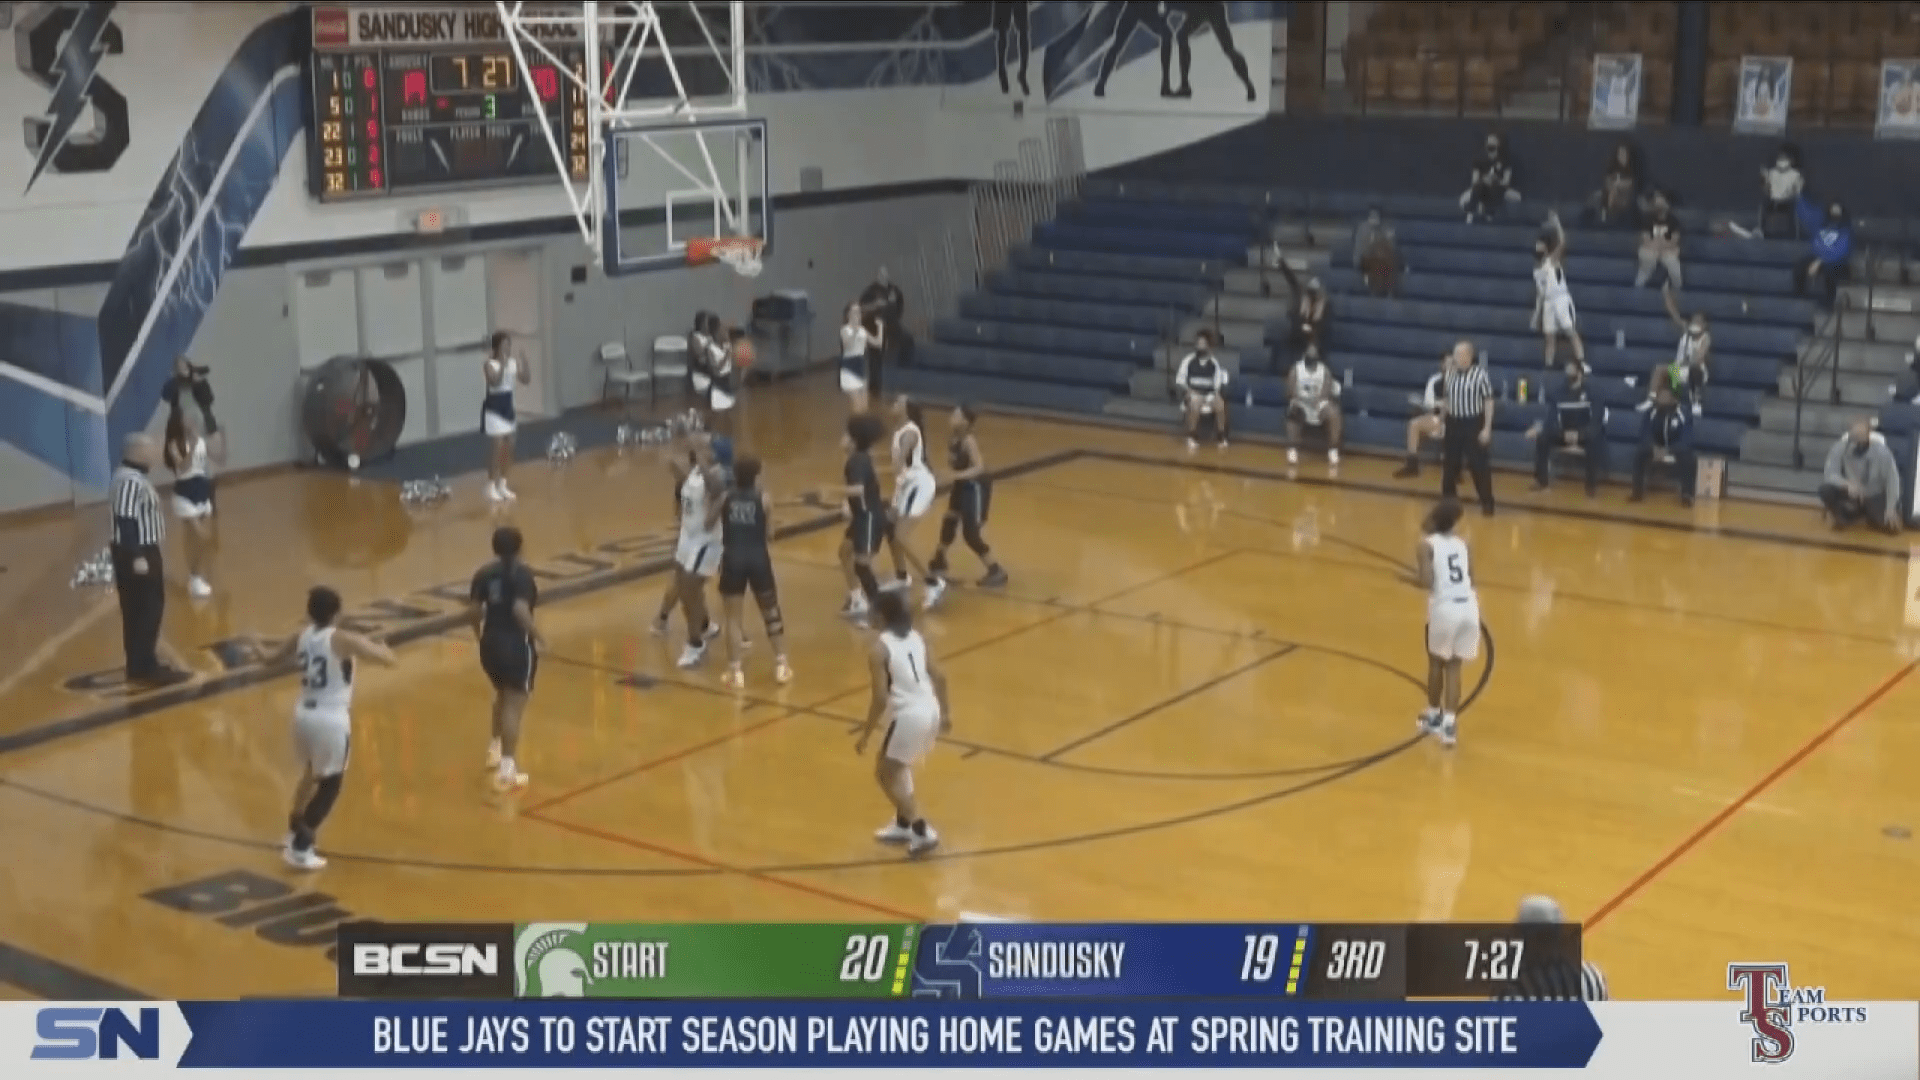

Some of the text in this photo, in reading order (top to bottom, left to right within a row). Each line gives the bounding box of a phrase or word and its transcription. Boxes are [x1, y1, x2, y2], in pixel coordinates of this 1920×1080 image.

[358, 12, 457, 39] SANDUSKY
[452, 58, 469, 89] 7
[482, 57, 512, 88] 27
[1447, 552, 1464, 584] 5
[907, 651, 920, 682] 1
